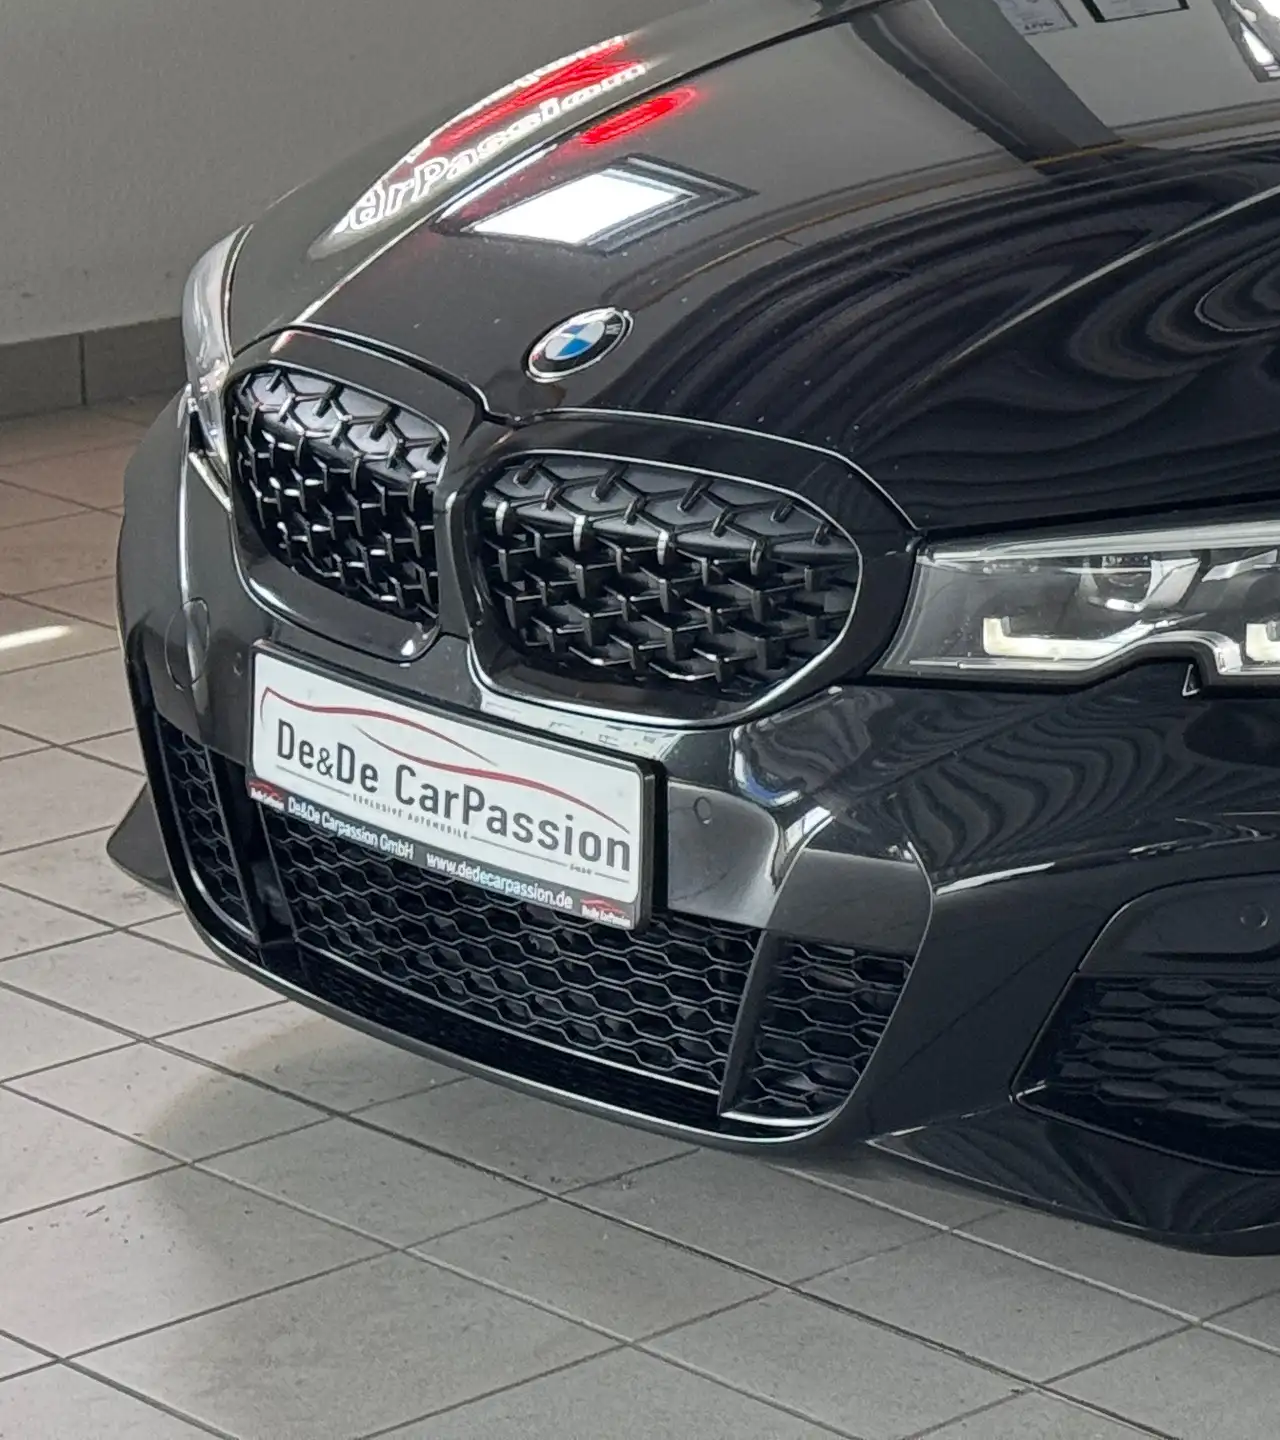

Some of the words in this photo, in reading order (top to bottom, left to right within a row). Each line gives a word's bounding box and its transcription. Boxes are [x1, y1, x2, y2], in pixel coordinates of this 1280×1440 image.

[277, 717, 379, 794] De&De
[395, 763, 631, 872] CarPassion
[321, 810, 378, 849] Carpassion
[379, 833, 415, 860] GmbH
[426, 851, 573, 911] www.dedecarpassion.de
